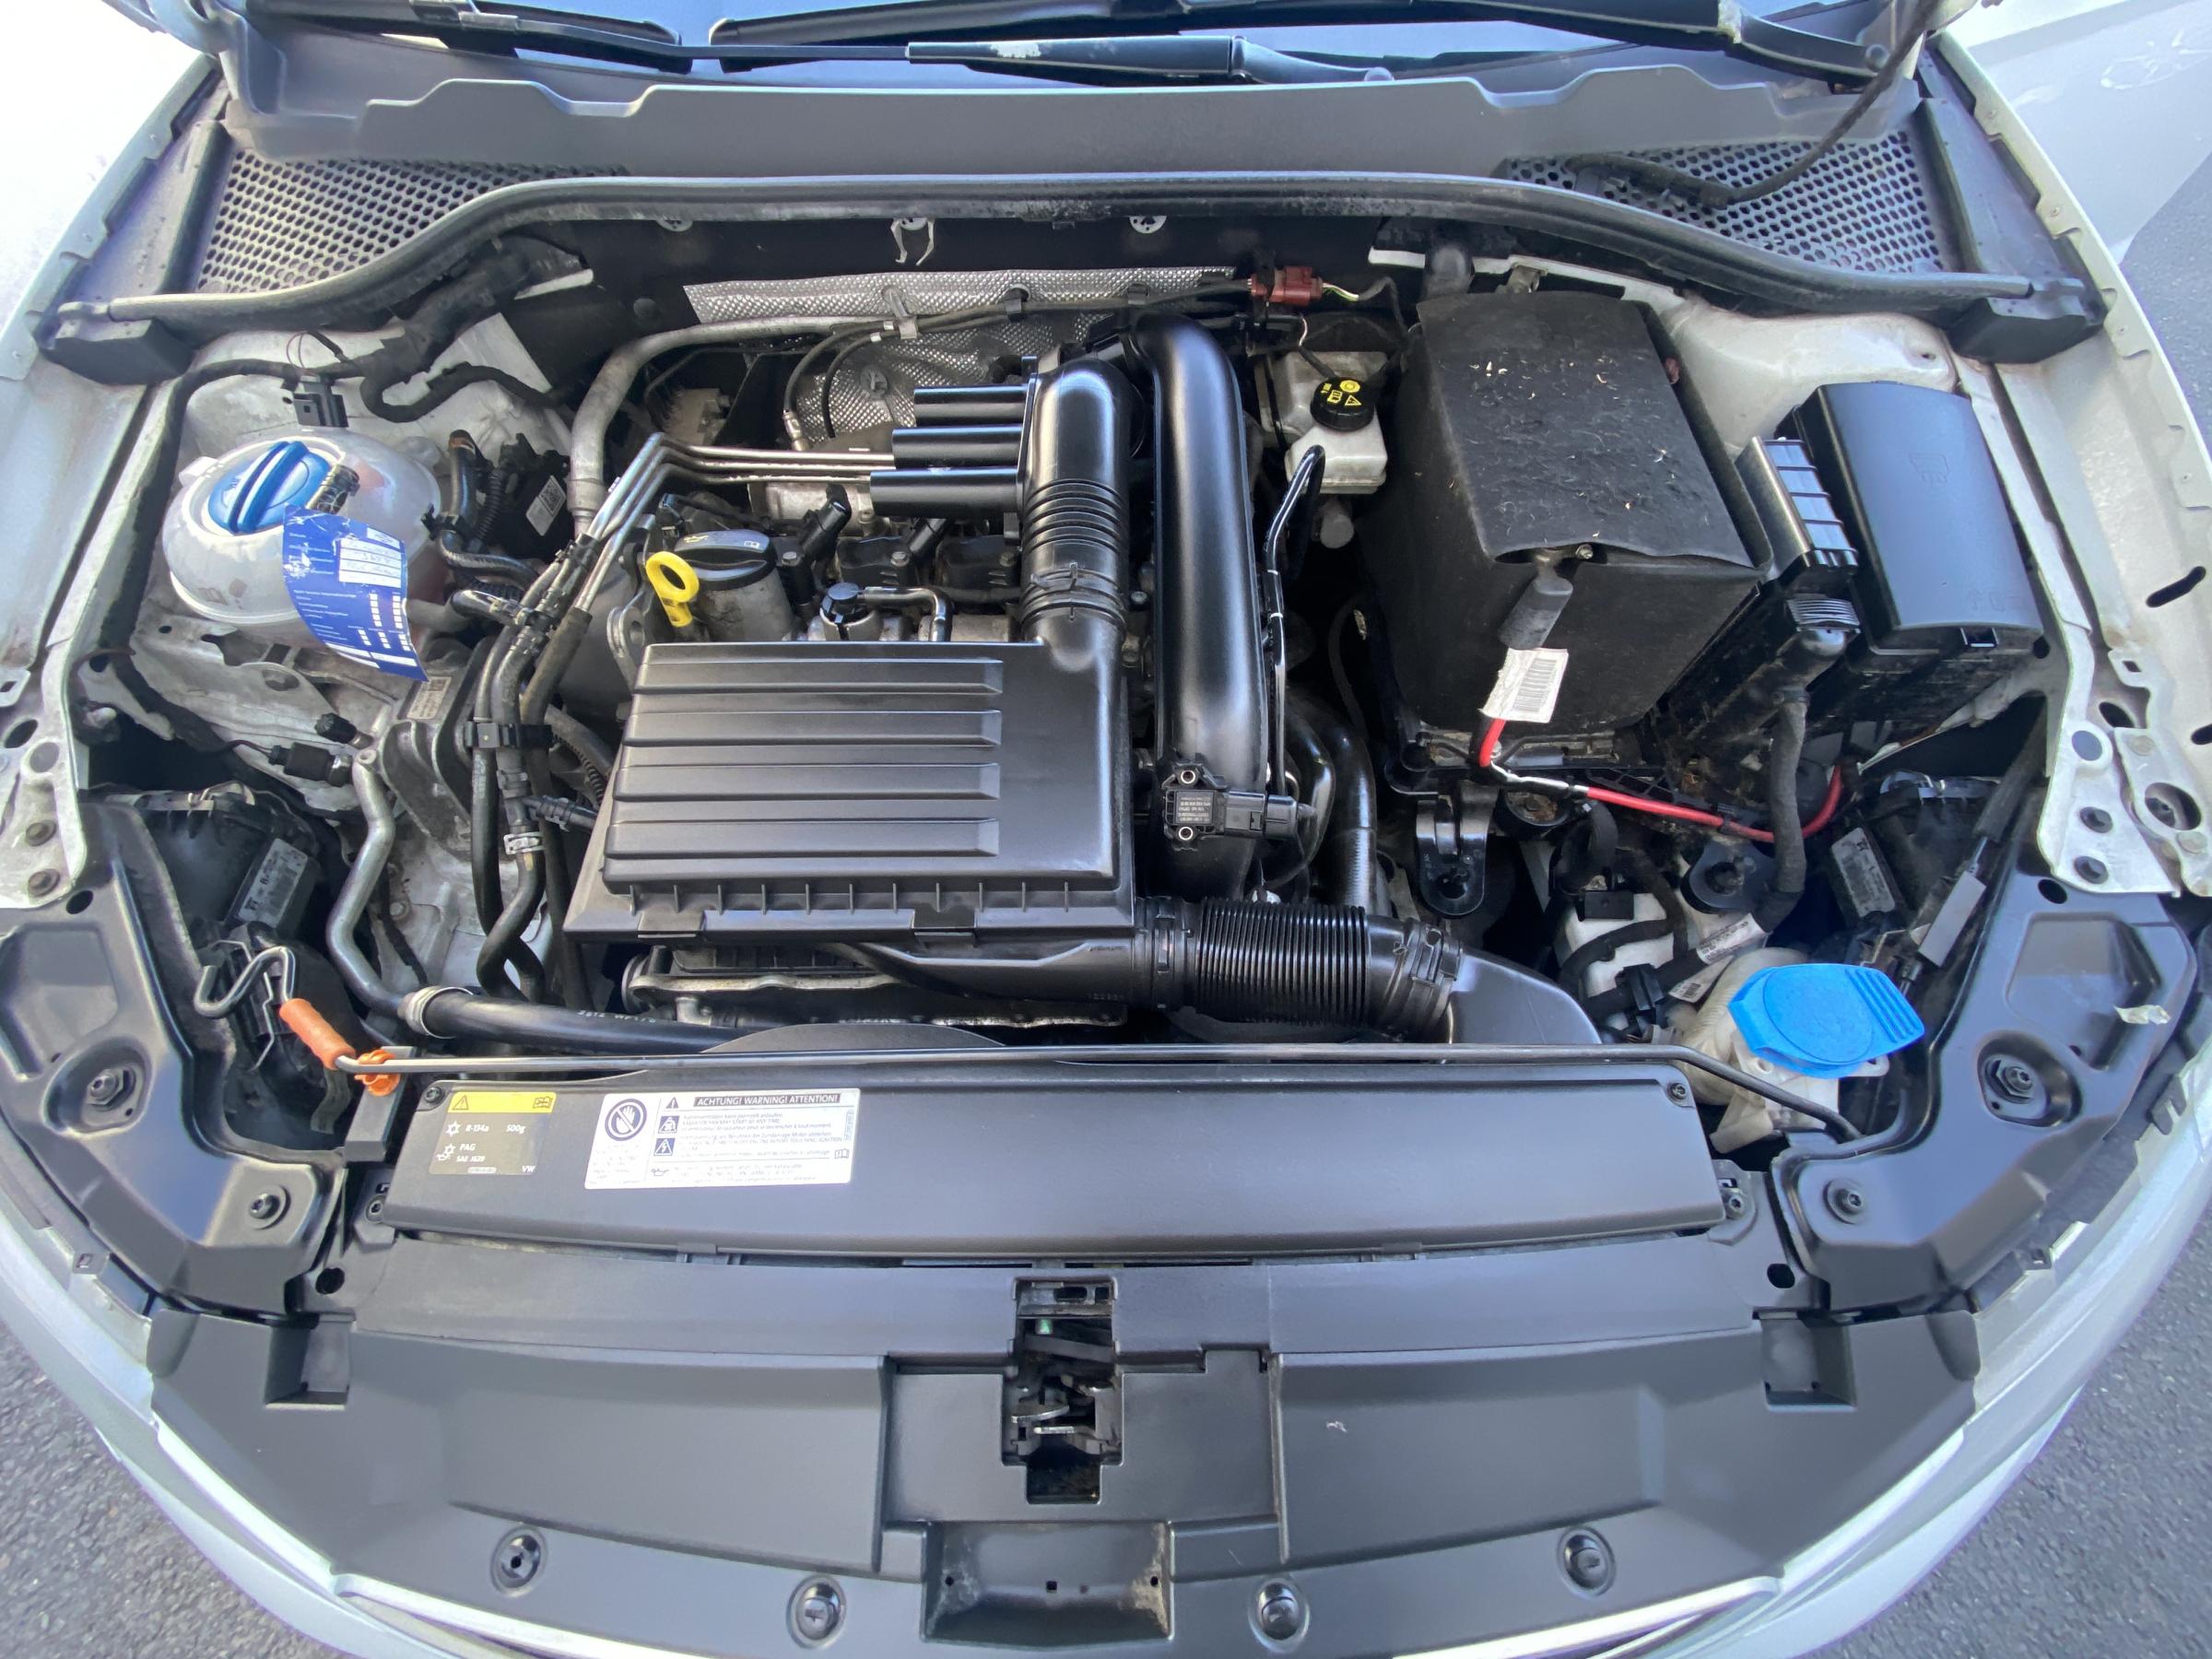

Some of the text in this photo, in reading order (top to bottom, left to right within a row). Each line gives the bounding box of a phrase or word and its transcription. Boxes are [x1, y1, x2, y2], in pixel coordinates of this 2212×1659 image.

[697, 1094, 838, 1106] ACHTUNG! WARNING! ATTENTION!
[465, 1124, 526, 1135] R-134a 500g
[459, 1143, 477, 1151] PAG
[522, 1165, 536, 1173] VW
